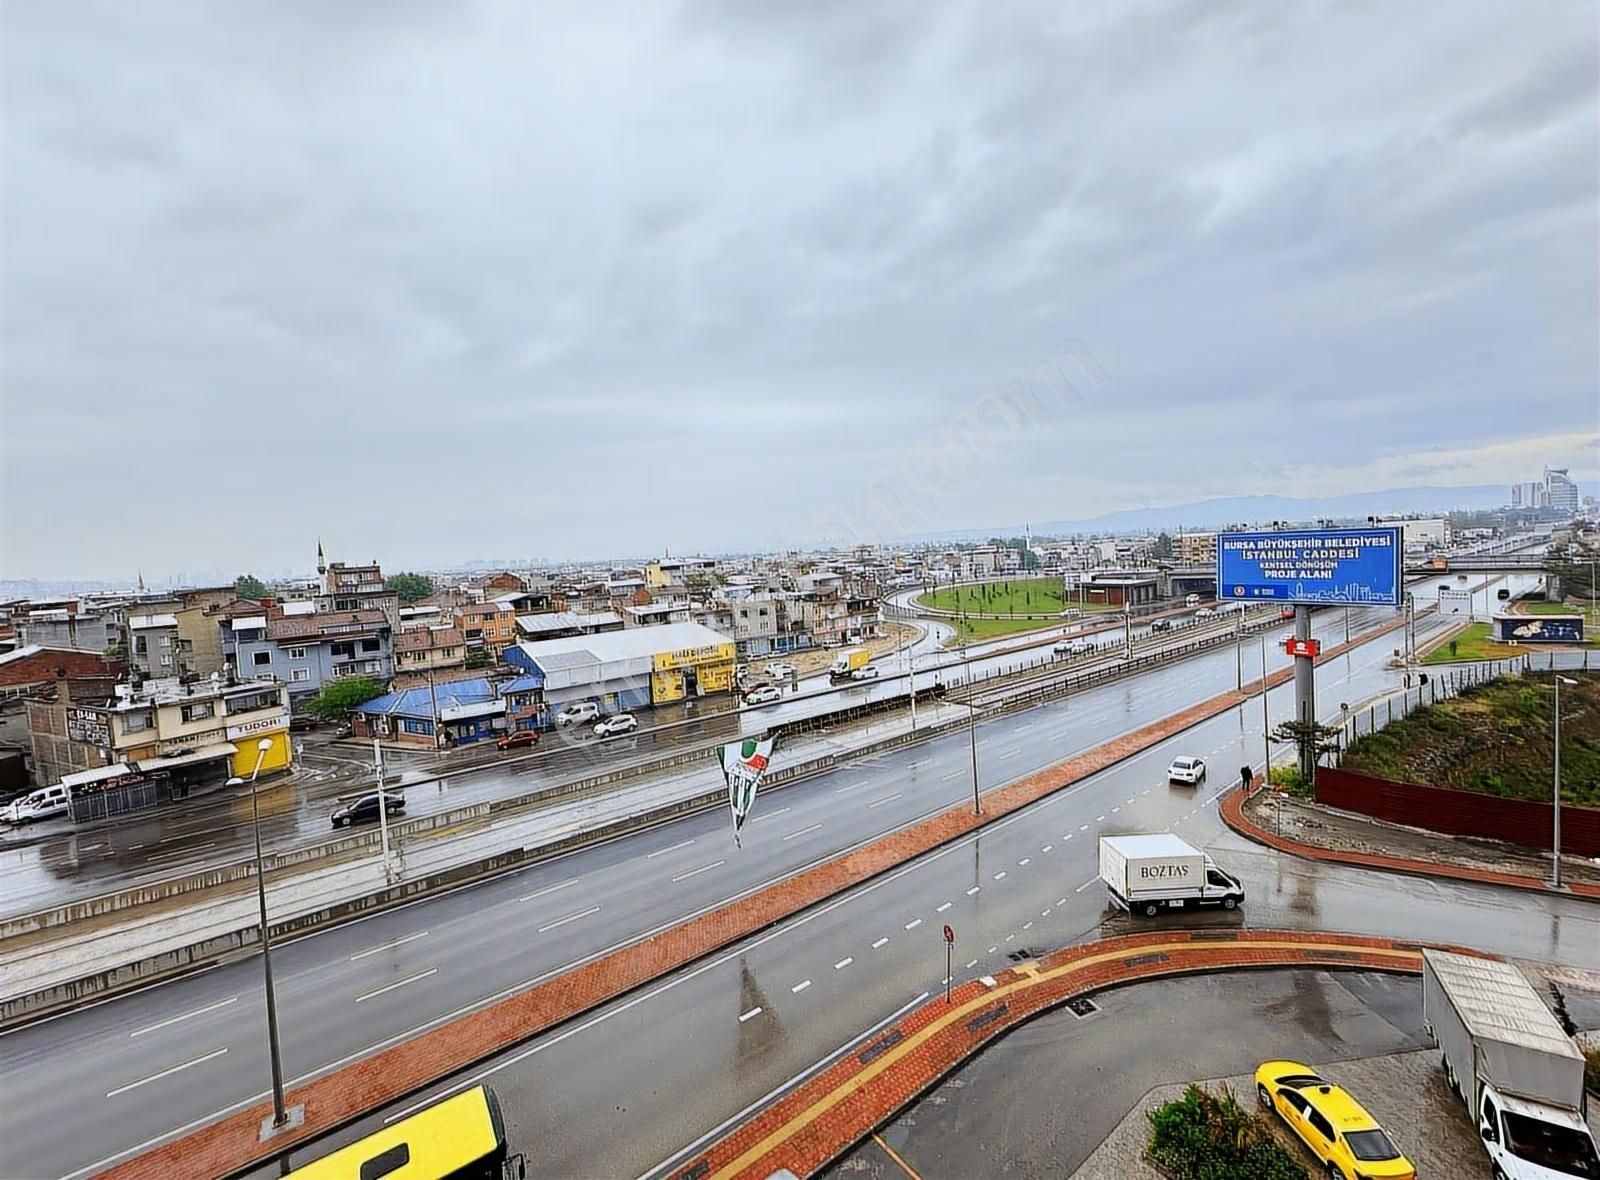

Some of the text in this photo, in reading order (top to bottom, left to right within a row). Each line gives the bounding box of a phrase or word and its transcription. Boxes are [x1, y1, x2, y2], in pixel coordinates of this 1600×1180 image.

[1224, 536, 1391, 550] BURSA BÜYÜKŞEHİR BELEDİYESİ
[1242, 548, 1359, 560] İSTANBUL CADDESİ
[1264, 570, 1333, 579] PROJE ALANI
